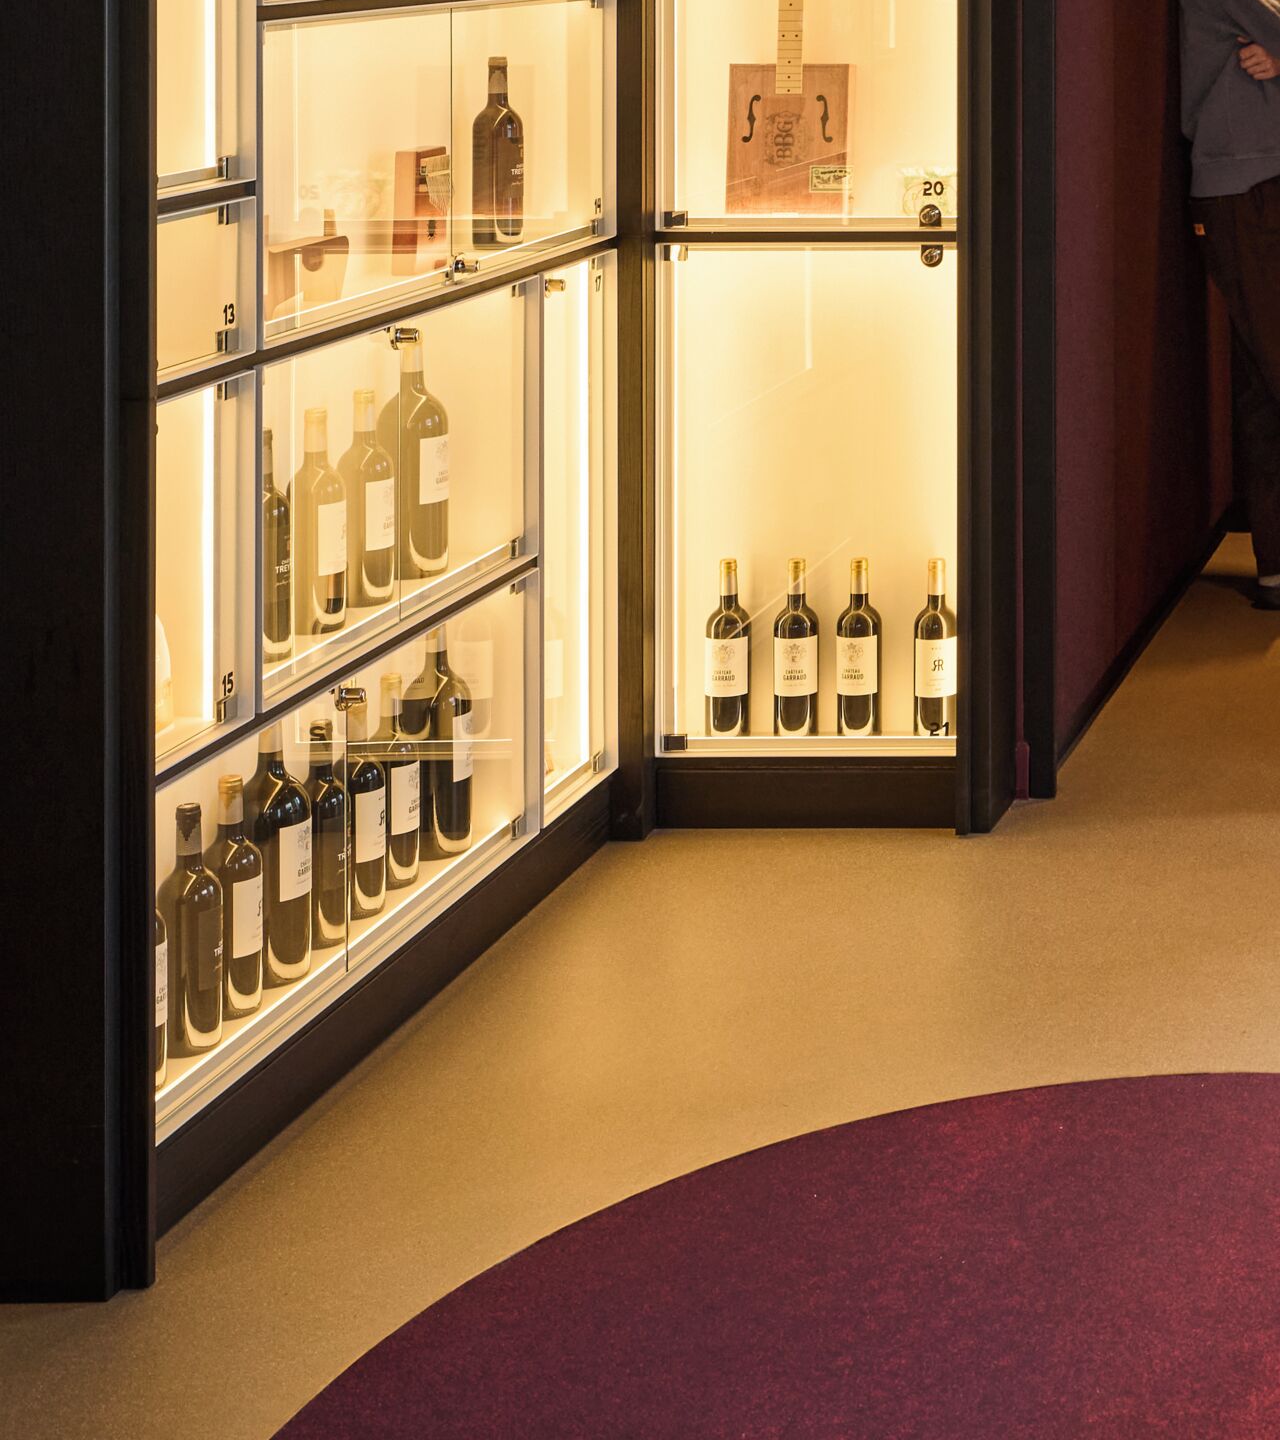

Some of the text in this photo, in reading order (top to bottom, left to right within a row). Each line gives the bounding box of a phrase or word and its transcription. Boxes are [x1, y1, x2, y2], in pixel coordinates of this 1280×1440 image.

[922, 181, 946, 197] 20
[595, 275, 602, 292] 17
[223, 303, 235, 326] 13
[222, 671, 234, 697] 15
[929, 722, 950, 737] 21
